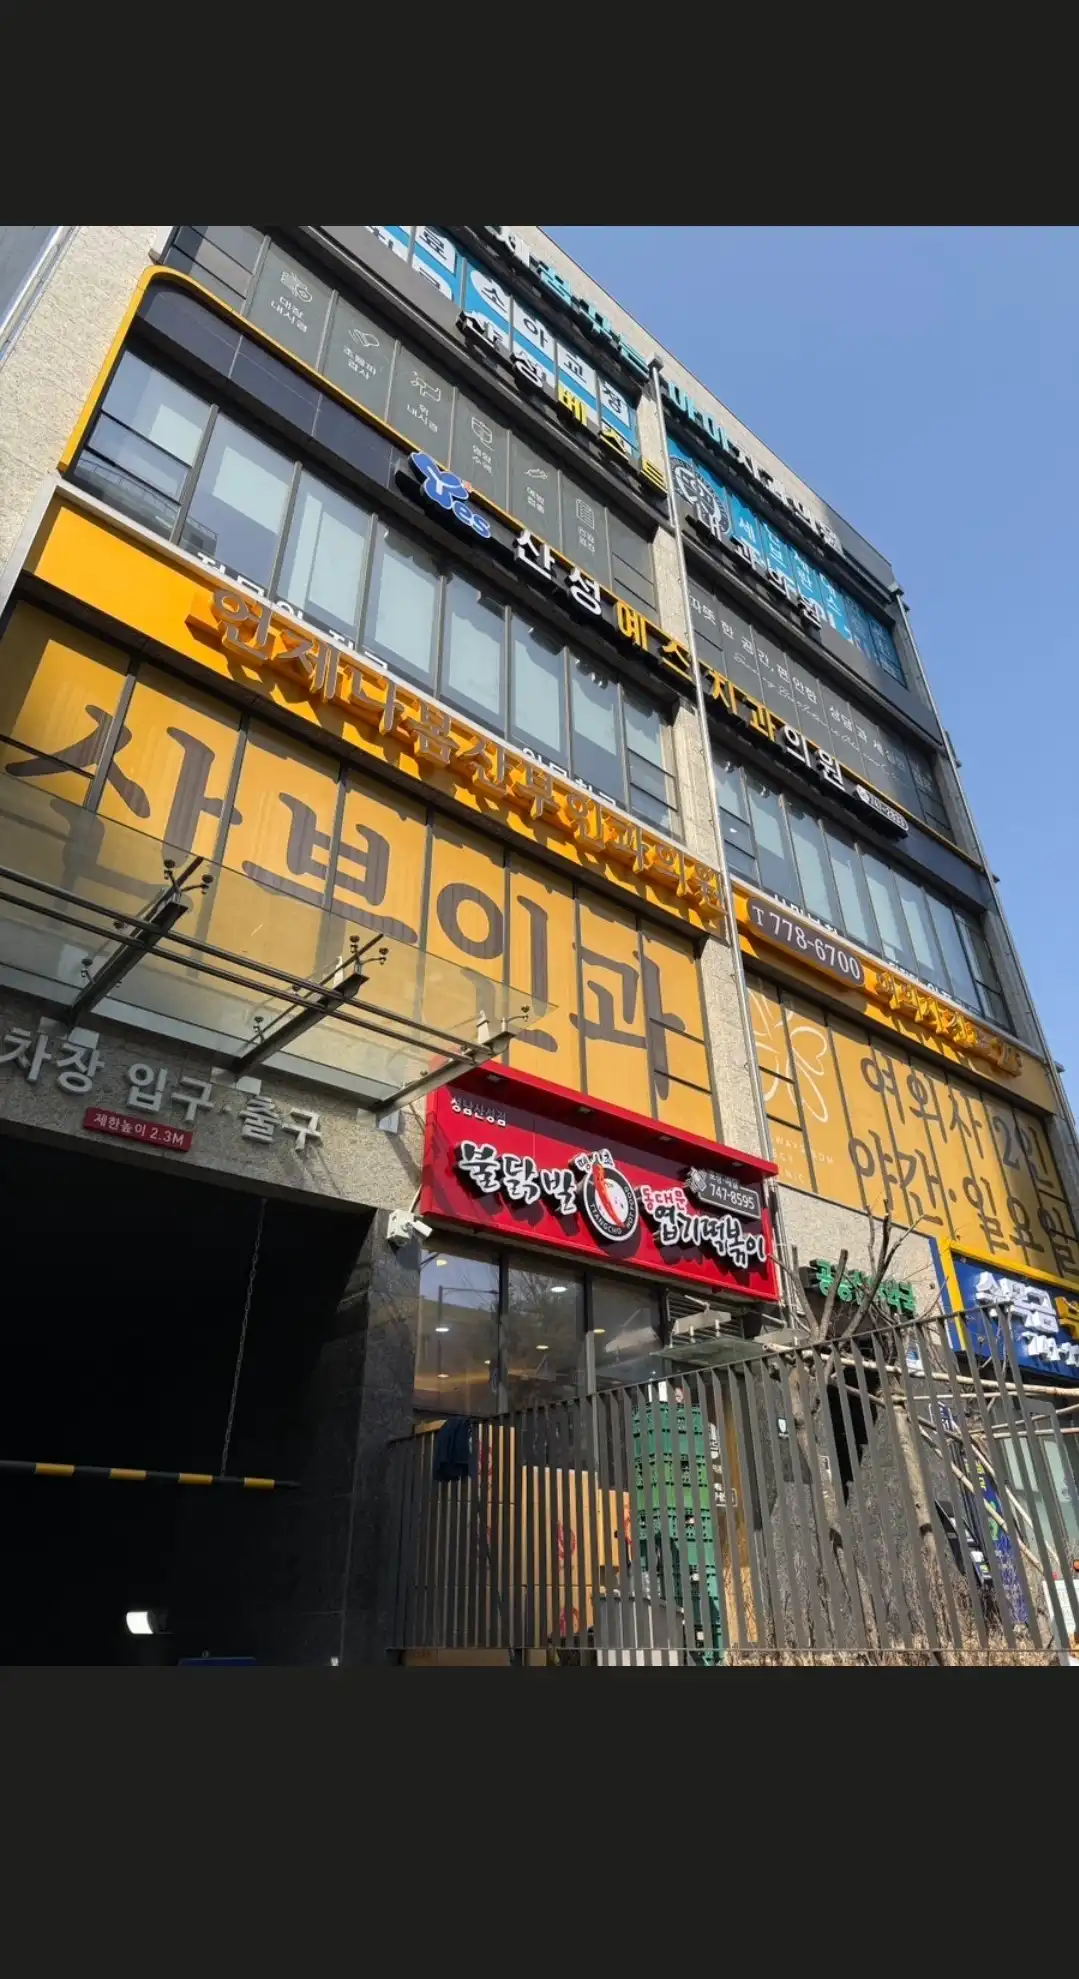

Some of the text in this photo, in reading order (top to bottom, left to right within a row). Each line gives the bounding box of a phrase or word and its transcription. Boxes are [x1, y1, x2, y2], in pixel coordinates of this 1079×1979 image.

[410, 451, 491, 539] Yes
[4, 702, 687, 1100] 산부인과
[770, 912, 862, 983] 778-6700
[93, 1113, 185, 1147] 제한높이 2.3M
[859, 1053, 984, 1160] 여의사
[458, 1140, 578, 1215] 불닭발
[640, 1185, 689, 1216] 동대문
[709, 1183, 756, 1210] 747-8595
[654, 1204, 767, 1269] 엽기떡볶이
